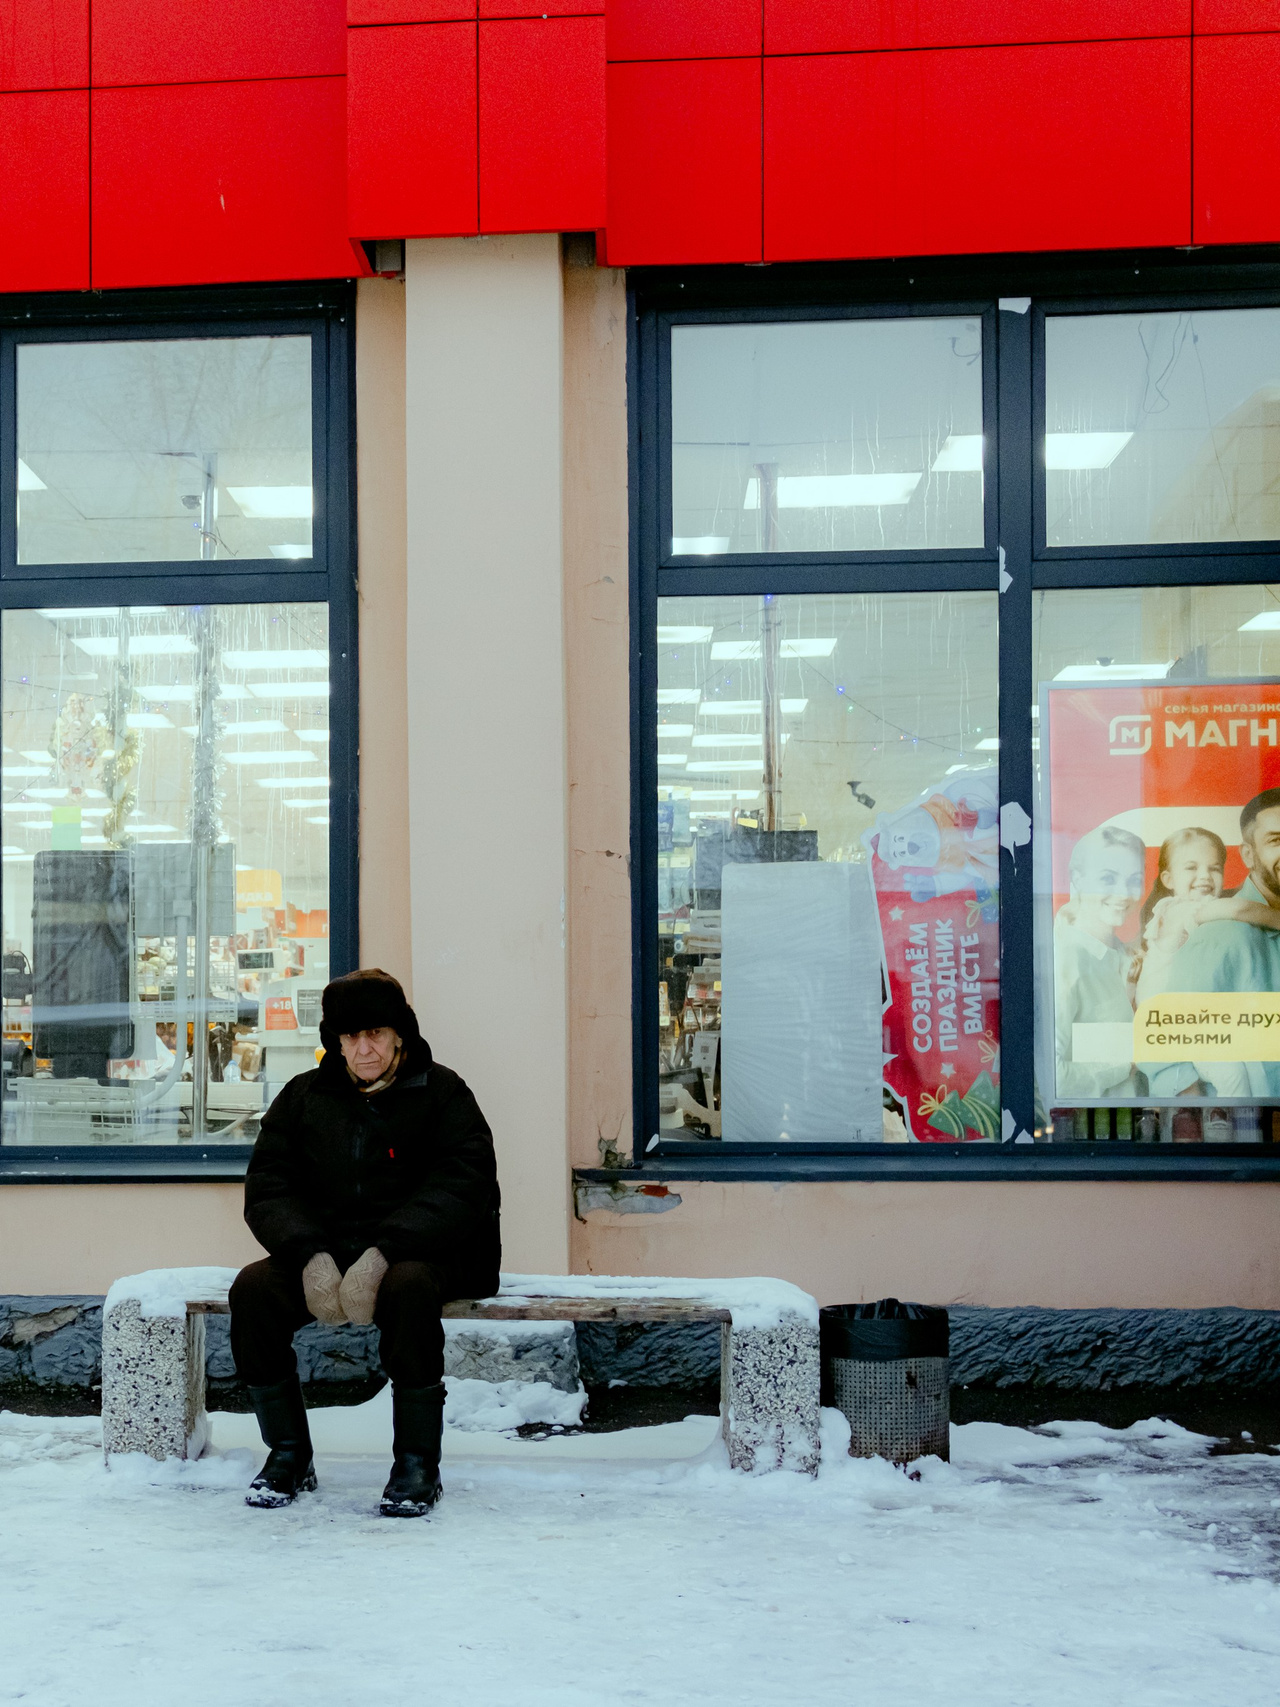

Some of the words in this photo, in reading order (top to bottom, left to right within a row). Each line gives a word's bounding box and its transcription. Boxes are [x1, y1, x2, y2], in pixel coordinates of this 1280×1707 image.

[1164, 704, 1209, 714] семья
[905, 923, 933, 1053] СОЗДАЁМ
[935, 918, 959, 1052] ПРАЗДНИК
[960, 932, 984, 1035] ВМЕСТЕ
[272, 1000, 292, 1010] +18
[1145, 1009, 1231, 1028] Давайте
[1145, 1033, 1232, 1045] семьями
